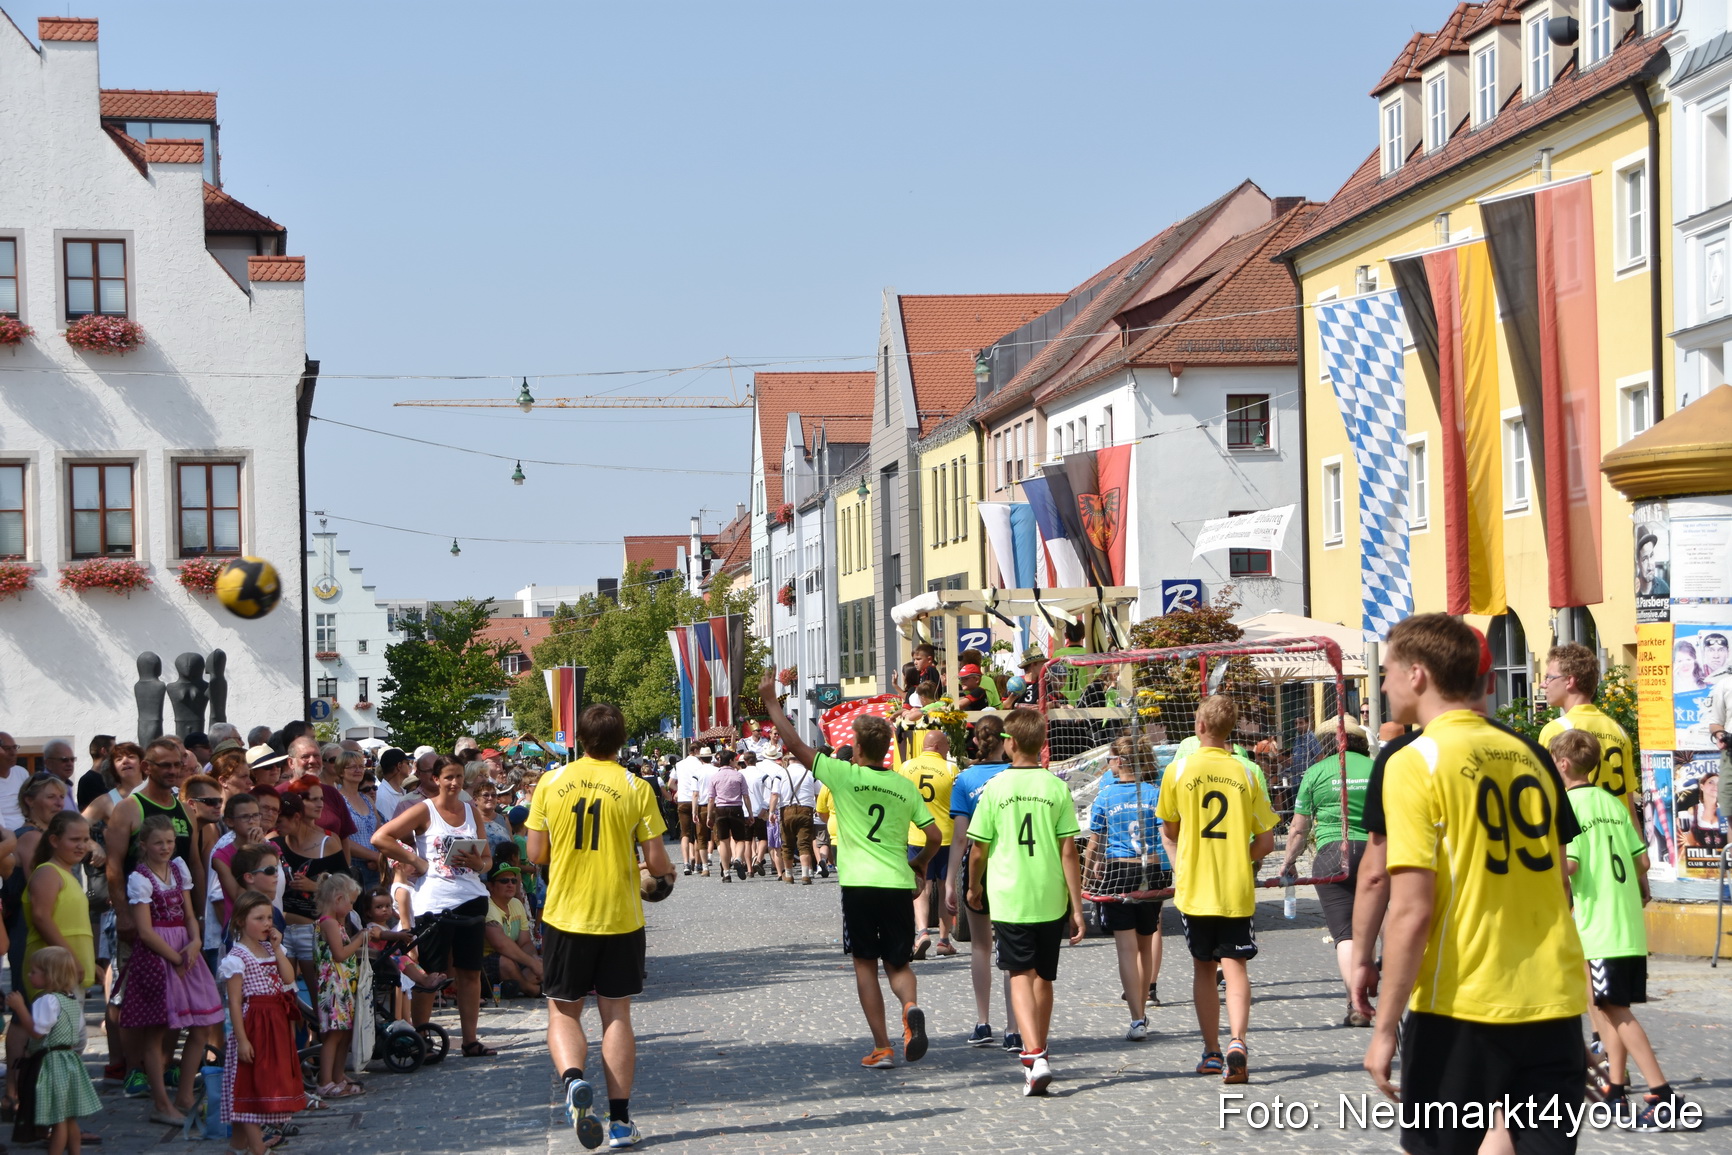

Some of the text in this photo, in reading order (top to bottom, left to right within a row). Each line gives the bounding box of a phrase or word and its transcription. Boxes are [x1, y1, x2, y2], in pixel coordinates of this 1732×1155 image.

[1024, 690, 1033, 702] 3
[1460, 749, 1483, 780] DJK
[1592, 746, 1627, 797] 3
[557, 779, 622, 802] DJK Neumarkt
[854, 785, 907, 804] DJK Neumarkt
[919, 774, 935, 802] 5
[1186, 774, 1246, 794] DJK Neumarkt
[999, 795, 1054, 810] DJK Neumarkt
[1108, 805, 1123, 816] DJK
[1201, 790, 1229, 840] 2
[571, 797, 602, 851] 11
[866, 803, 885, 843] 2
[1018, 812, 1036, 857] 4
[1476, 774, 1554, 875] 99
[1607, 835, 1627, 884] 6
